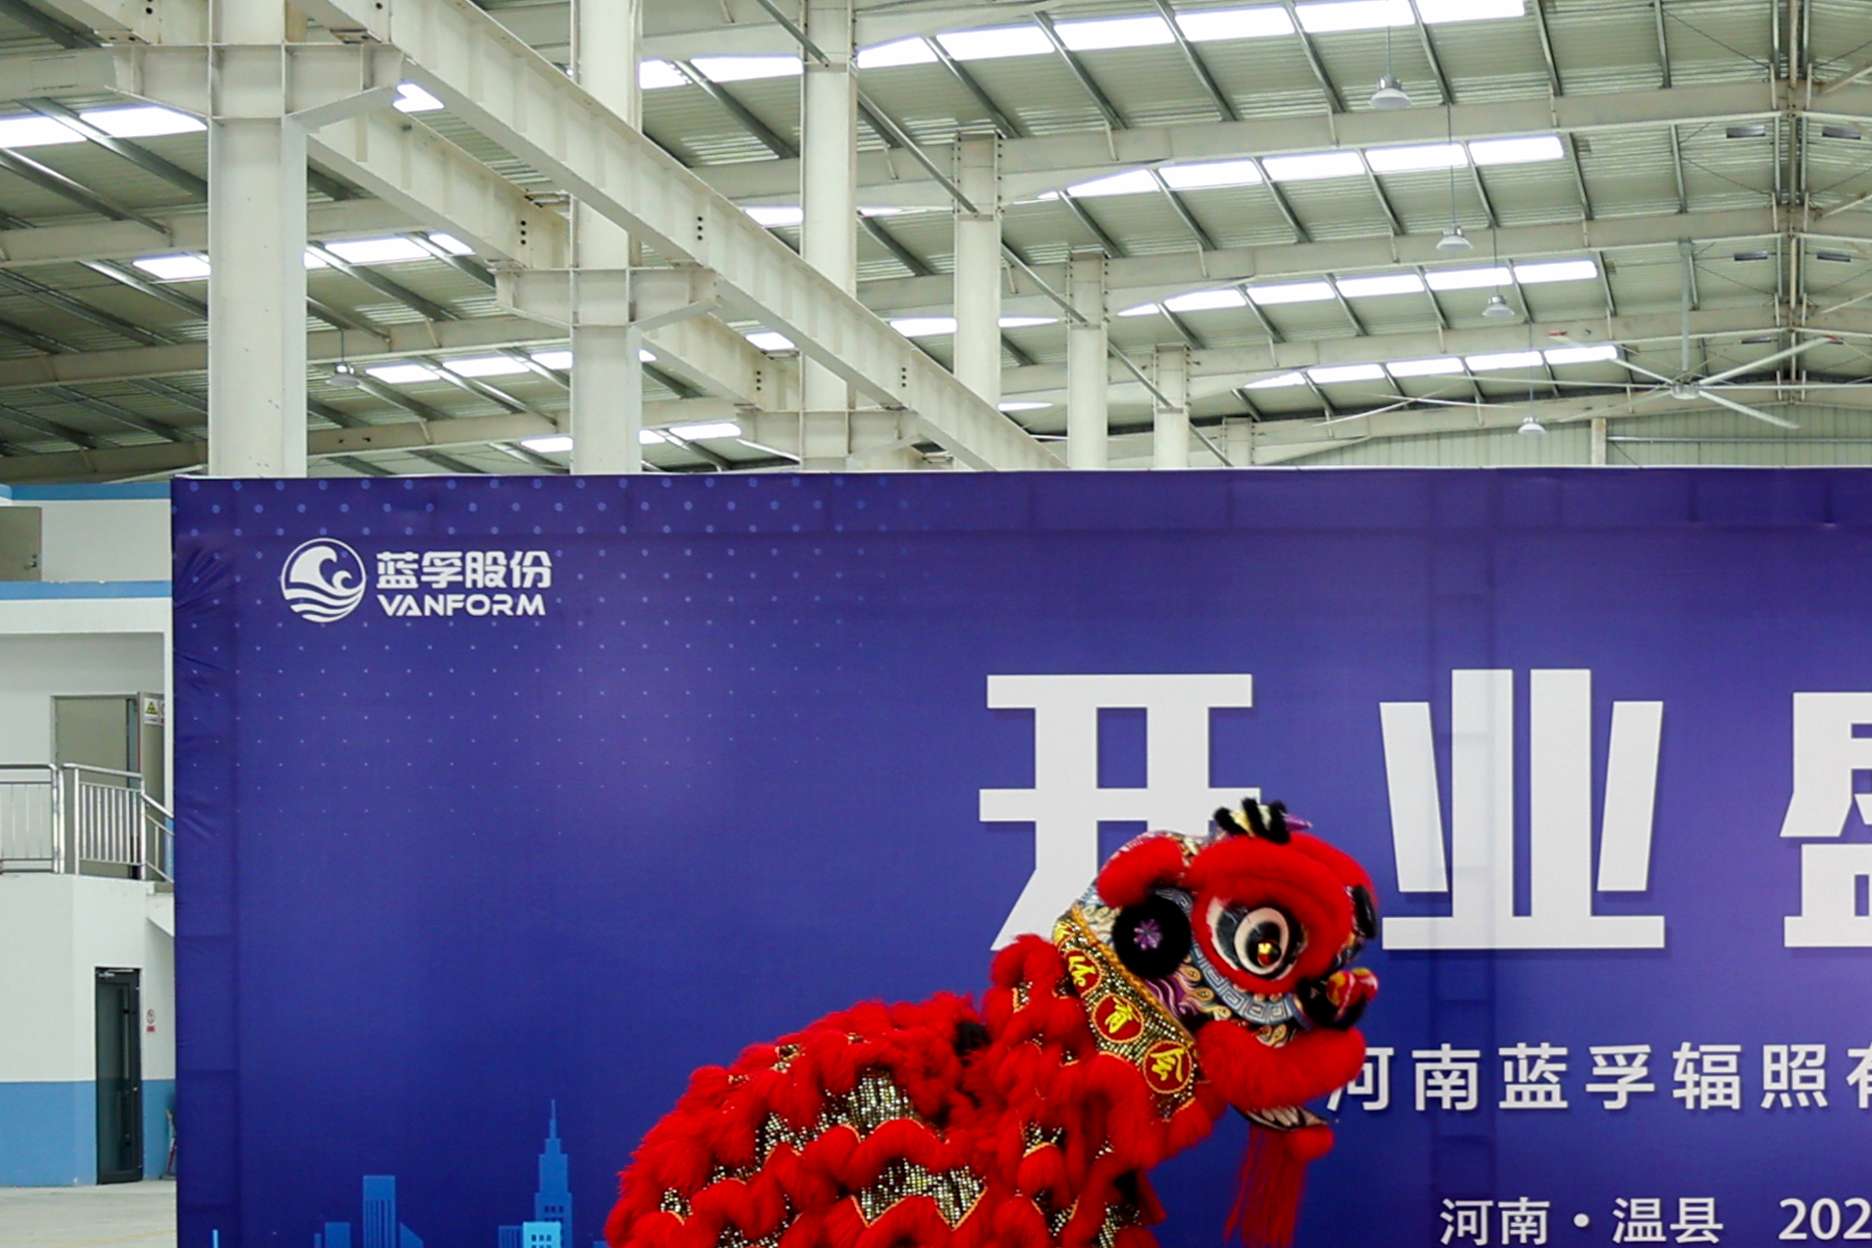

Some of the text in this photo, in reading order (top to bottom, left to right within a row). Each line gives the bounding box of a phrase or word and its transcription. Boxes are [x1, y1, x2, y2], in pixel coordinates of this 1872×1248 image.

[376, 550, 551, 589] 蓝孚股份
[378, 594, 545, 616] VANFORM
